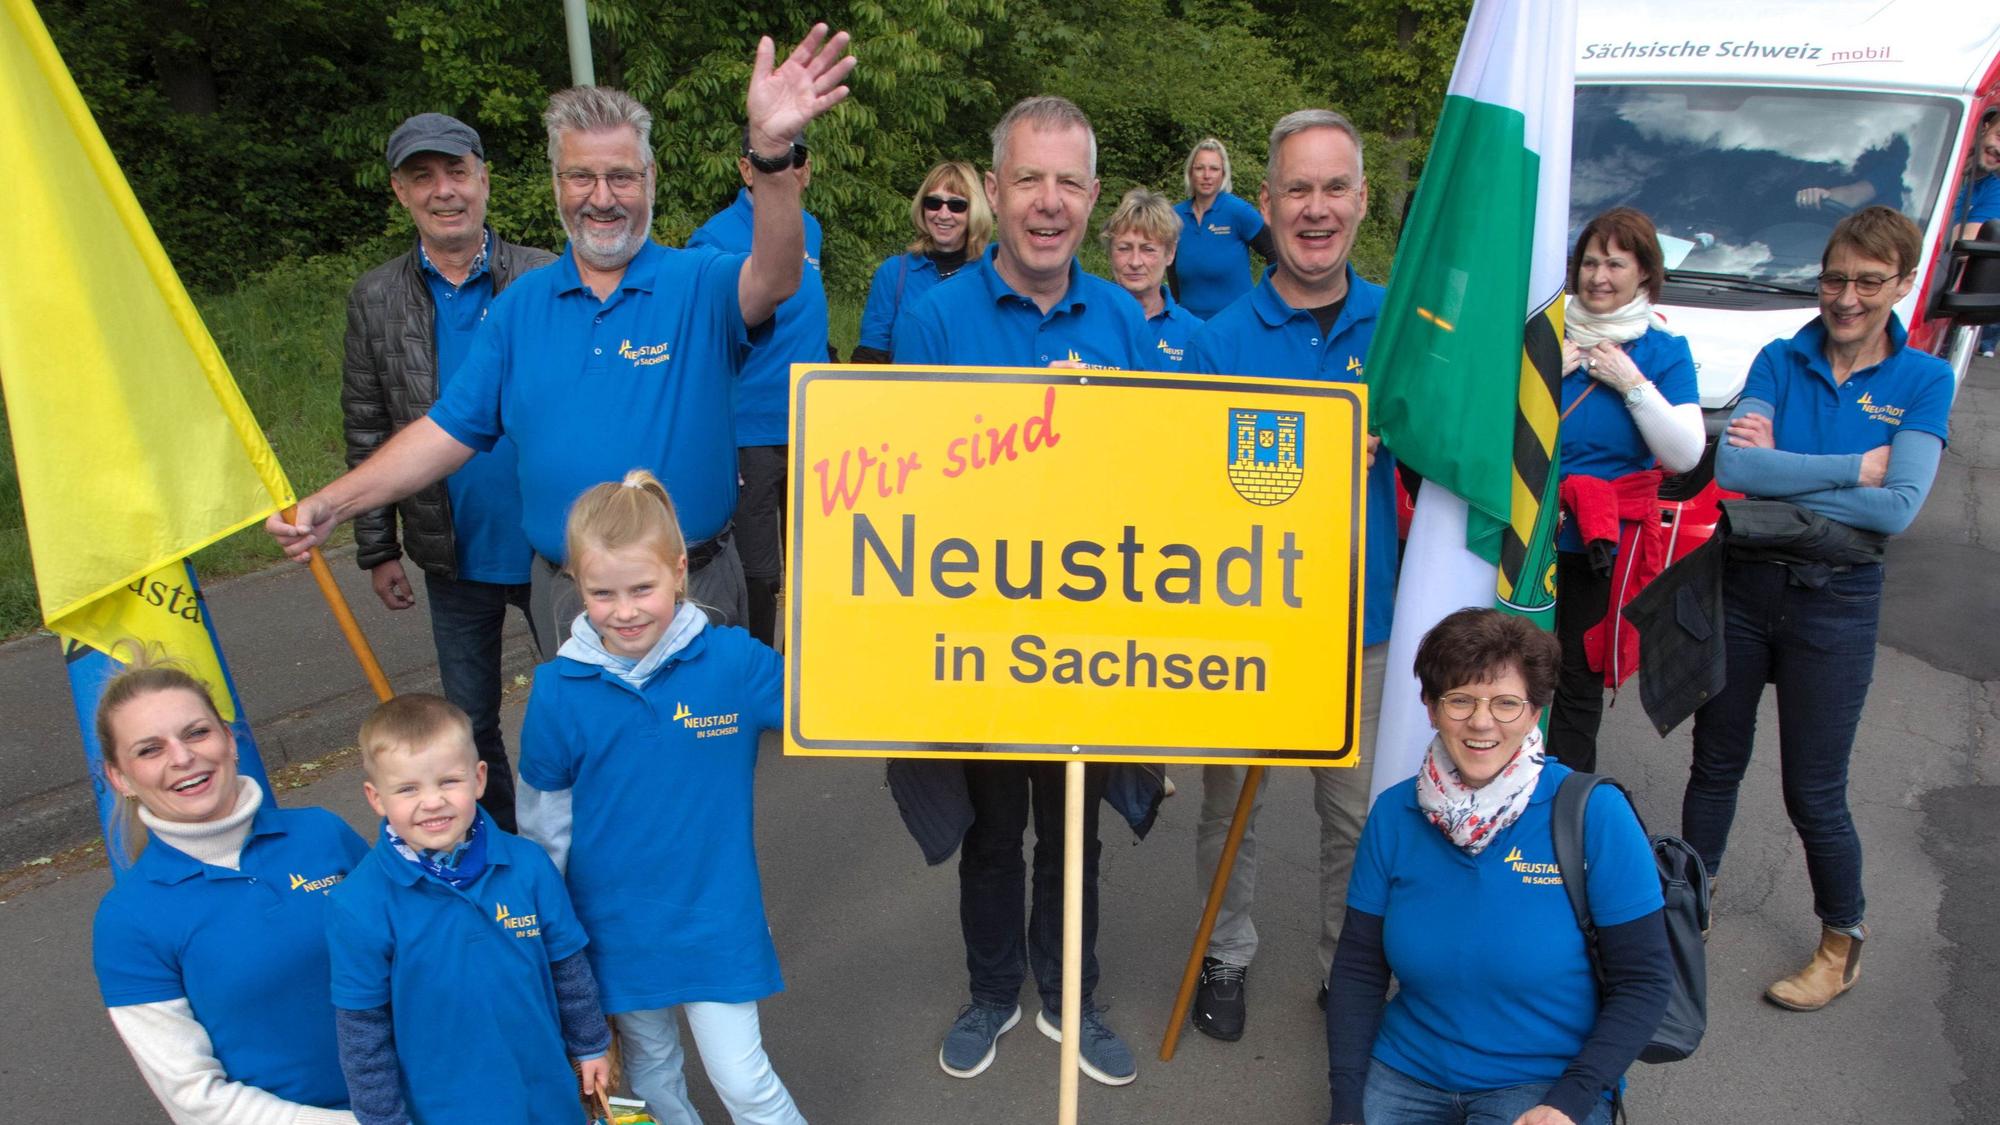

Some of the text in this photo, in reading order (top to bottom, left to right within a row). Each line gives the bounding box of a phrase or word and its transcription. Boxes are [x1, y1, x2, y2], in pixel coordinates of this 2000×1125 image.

[1581, 40, 1892, 61] Sächsische Schweiz mobil
[813, 386, 1061, 517] Wir sind
[852, 513, 1303, 608] Neustadt
[935, 633, 1266, 692] in Sachsen
[684, 713, 739, 728] NEUSTADT
[696, 726, 739, 738] IN SACHSEN
[1522, 876, 1532, 884] IN
